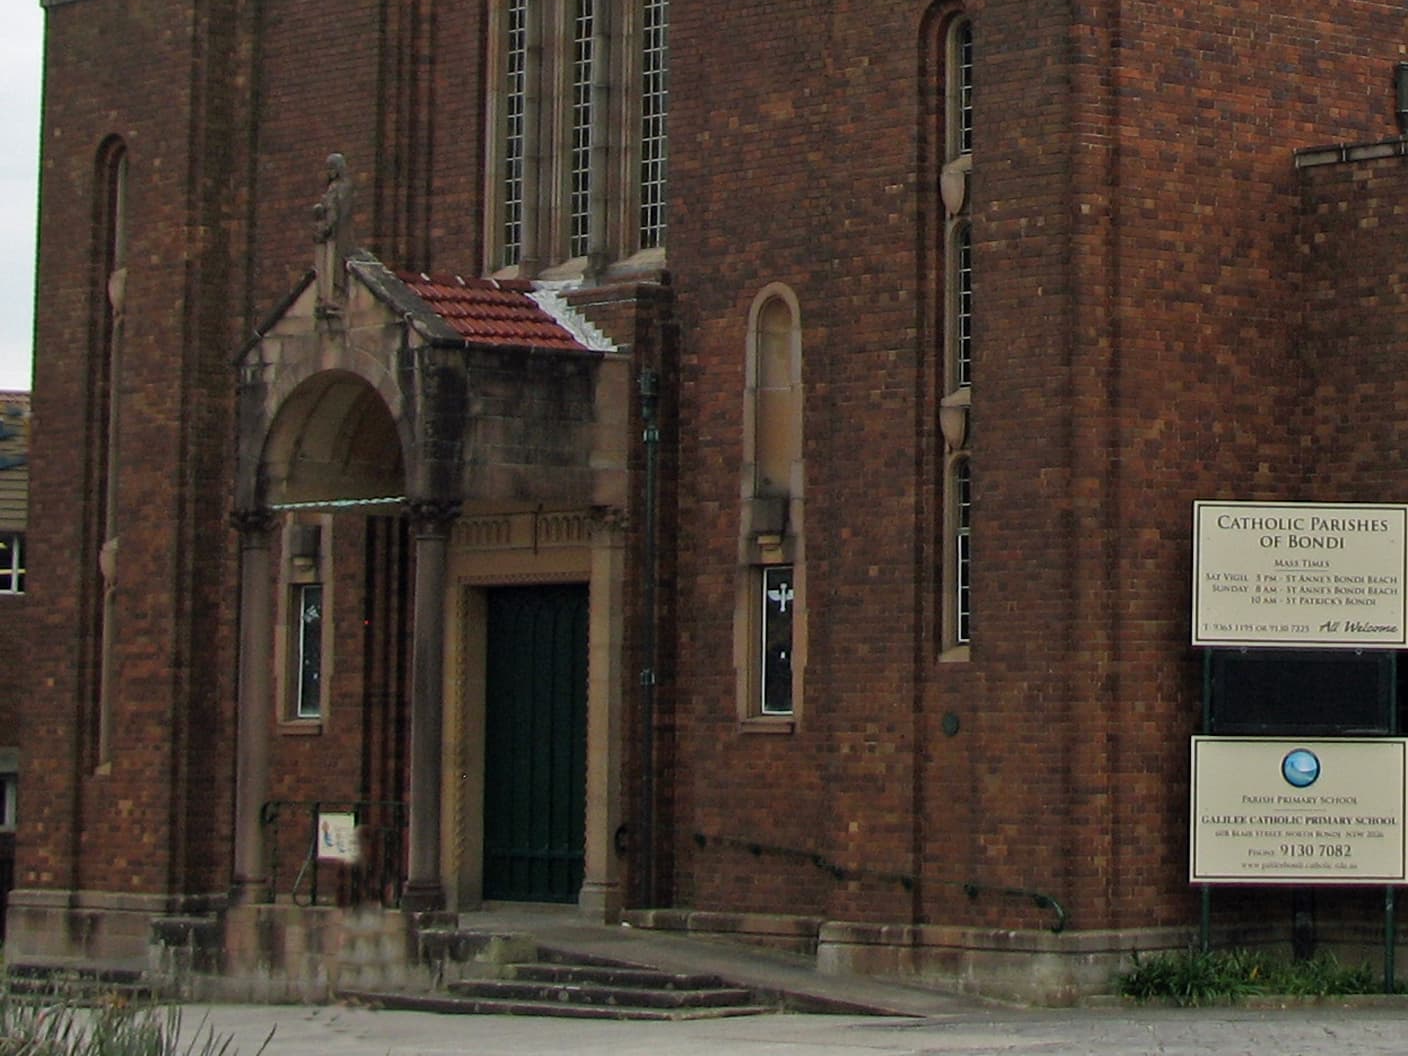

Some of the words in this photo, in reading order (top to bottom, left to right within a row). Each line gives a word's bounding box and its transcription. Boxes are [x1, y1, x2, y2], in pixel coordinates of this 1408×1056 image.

[1260, 535, 1281, 548] OF
[1344, 620, 1398, 633] Welcome
[1249, 815, 1304, 825] CATHOLIC
[1305, 816, 1352, 825] PRIMARY
[1355, 816, 1397, 825] SCHOOL
[1279, 844, 1314, 857] 9130
[1319, 844, 1352, 857] 7082
